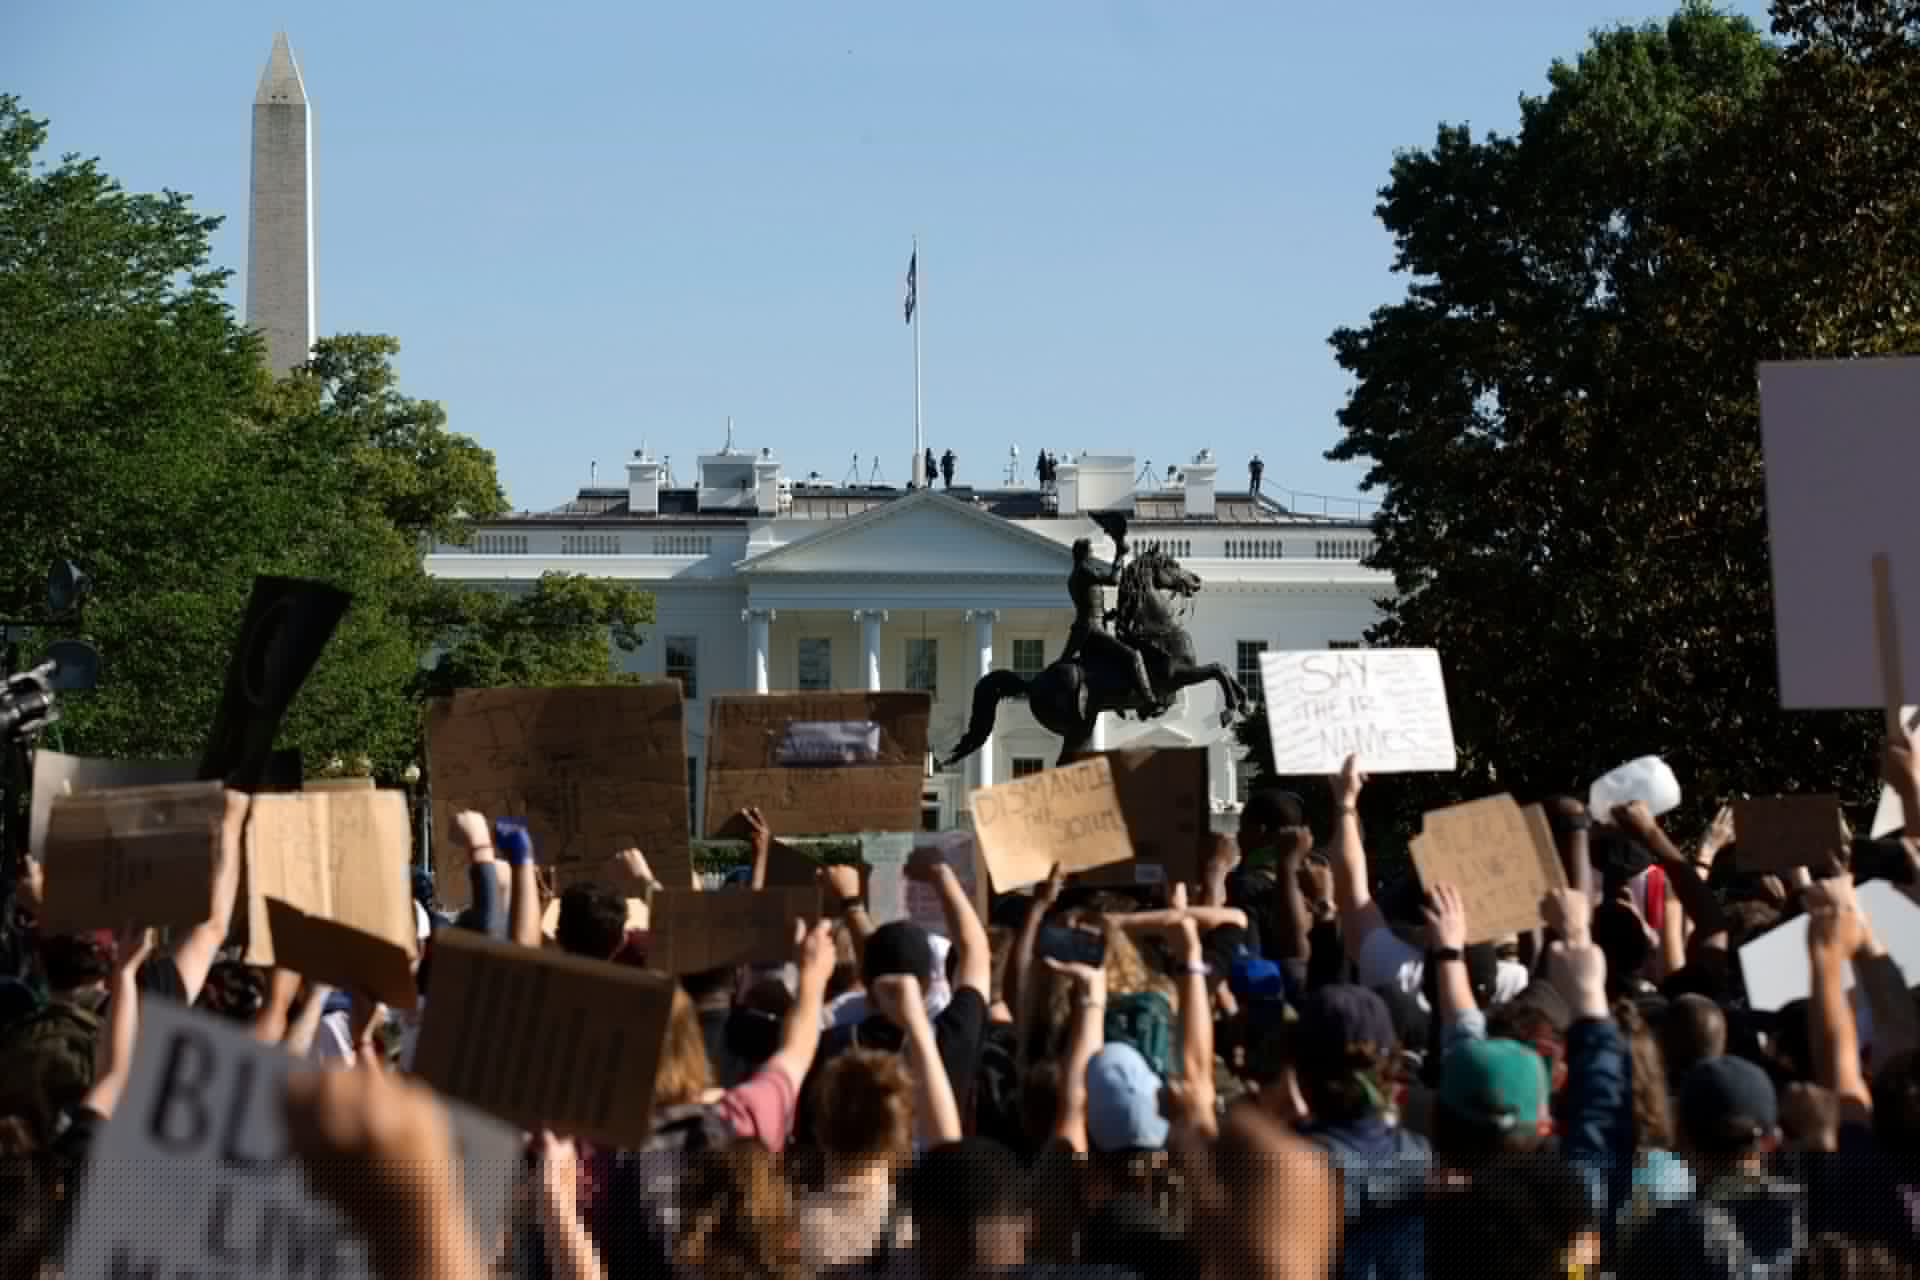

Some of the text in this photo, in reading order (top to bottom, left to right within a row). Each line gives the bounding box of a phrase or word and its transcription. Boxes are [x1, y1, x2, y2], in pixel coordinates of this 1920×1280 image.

[1300, 654, 1368, 695] SAY
[1320, 722, 1420, 760] NAMES
[144, 1026, 289, 1176] BL
